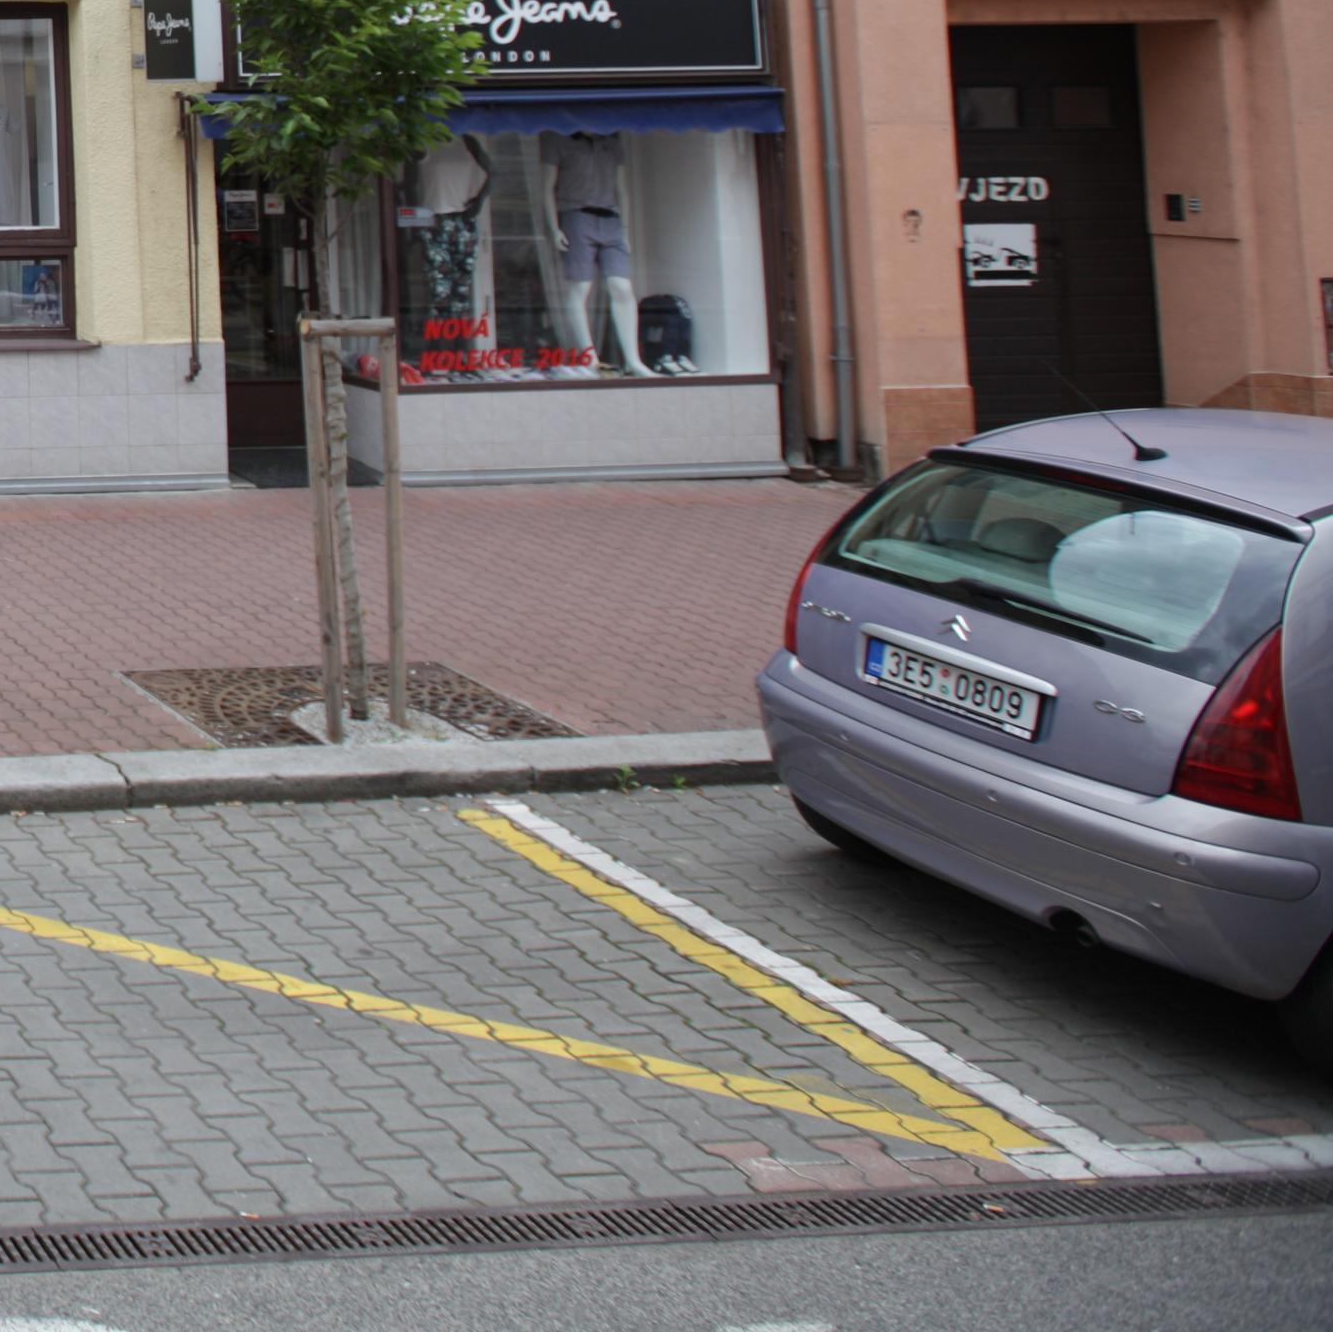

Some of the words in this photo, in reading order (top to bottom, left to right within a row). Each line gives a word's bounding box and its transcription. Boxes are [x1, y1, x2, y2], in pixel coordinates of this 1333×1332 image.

[424, 313, 489, 340] NOVÁ
[421, 347, 525, 372] KOLEKCE
[535, 344, 596, 369] 2016
[888, 652, 935, 688] 3E5
[954, 674, 1023, 719] 0809
